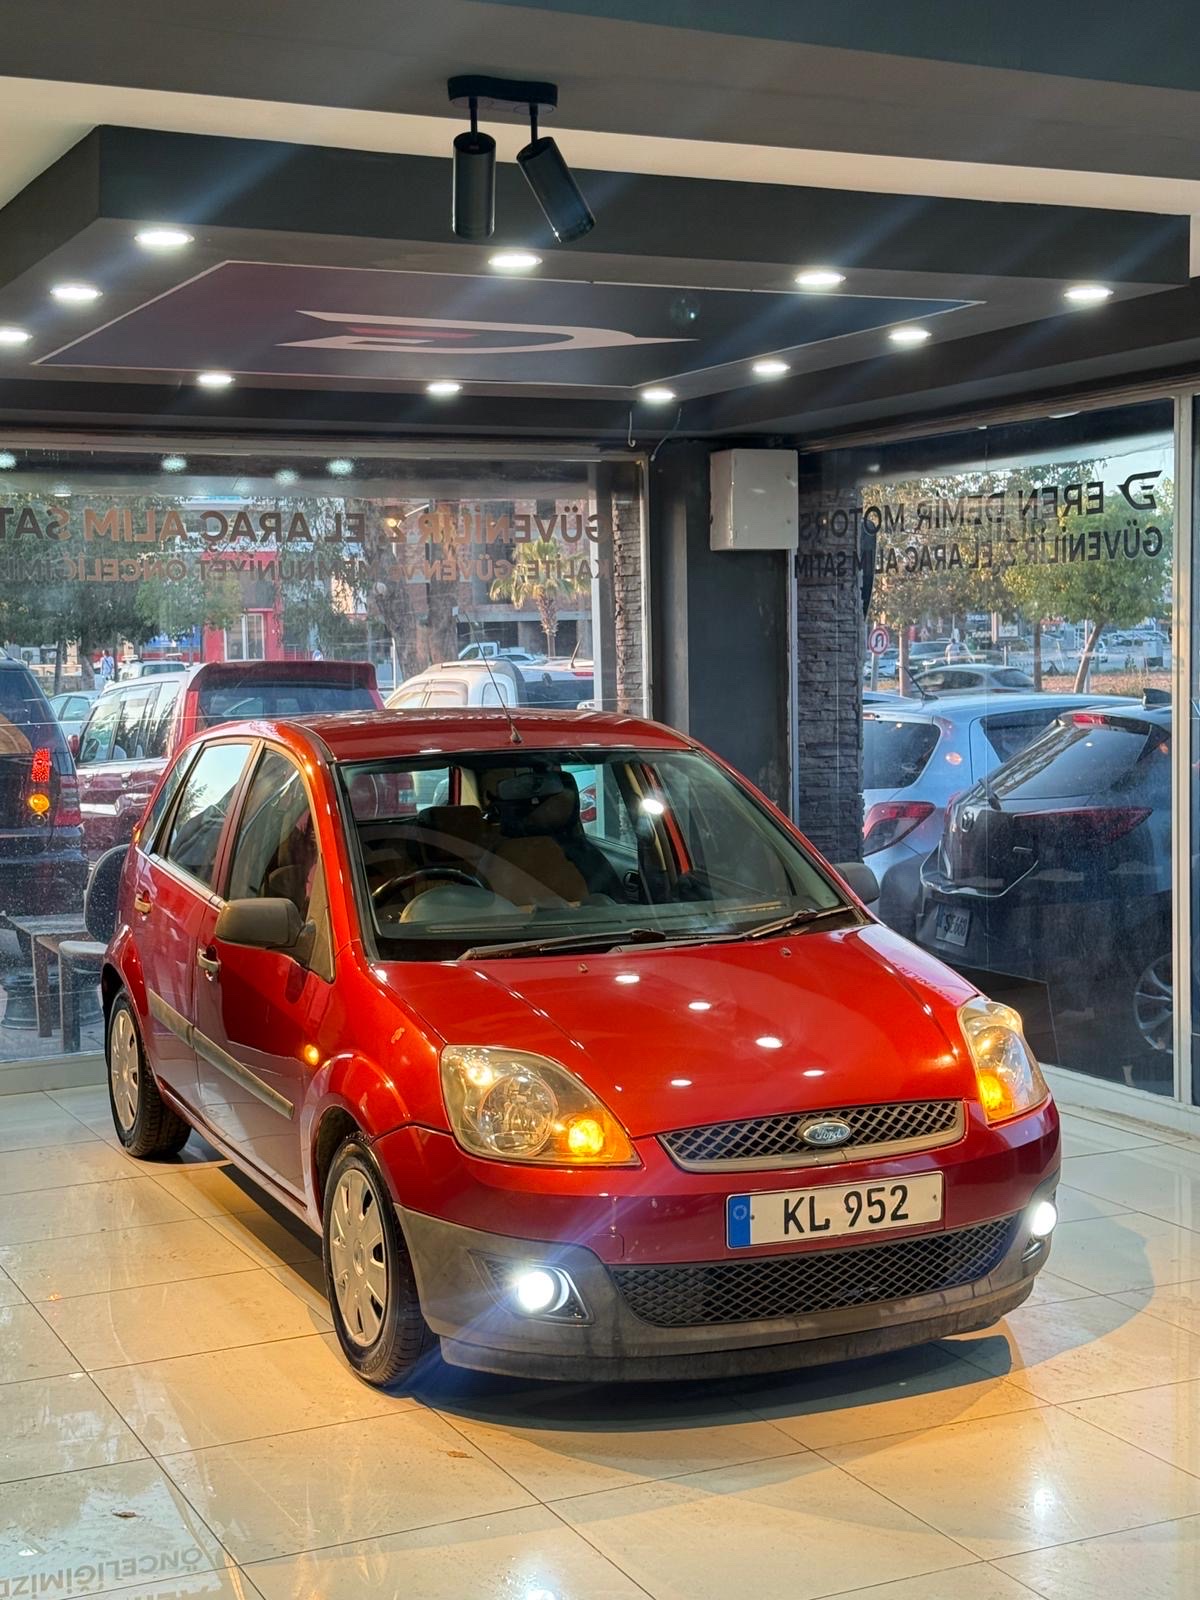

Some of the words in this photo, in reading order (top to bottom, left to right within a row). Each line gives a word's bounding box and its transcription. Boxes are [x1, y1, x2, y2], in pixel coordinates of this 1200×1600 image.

[814, 1126, 842, 1140] Ford
[783, 1195, 831, 1235] KL
[843, 1184, 909, 1228] 952
